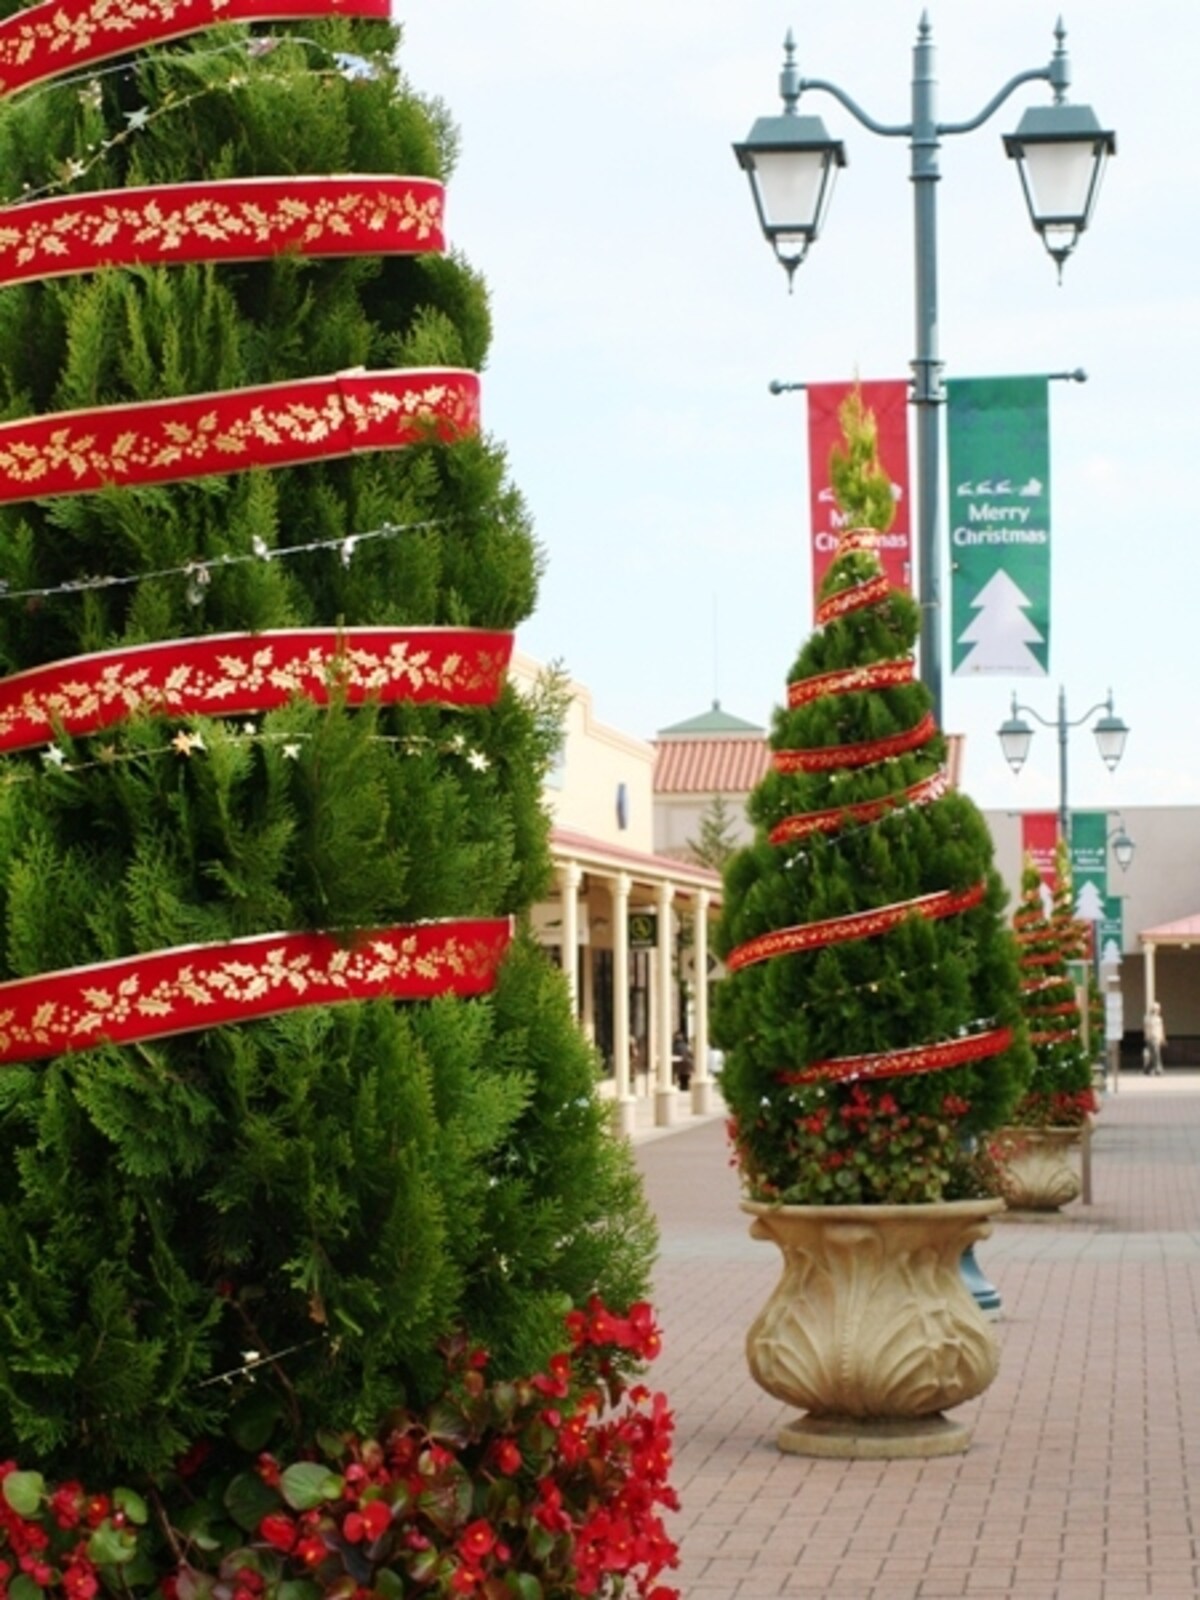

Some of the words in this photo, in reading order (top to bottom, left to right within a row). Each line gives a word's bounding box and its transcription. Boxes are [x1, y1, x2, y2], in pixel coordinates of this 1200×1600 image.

[968, 503, 1031, 523] Merry
[815, 532, 908, 552] Chmas
[954, 526, 1046, 546] Christmas
